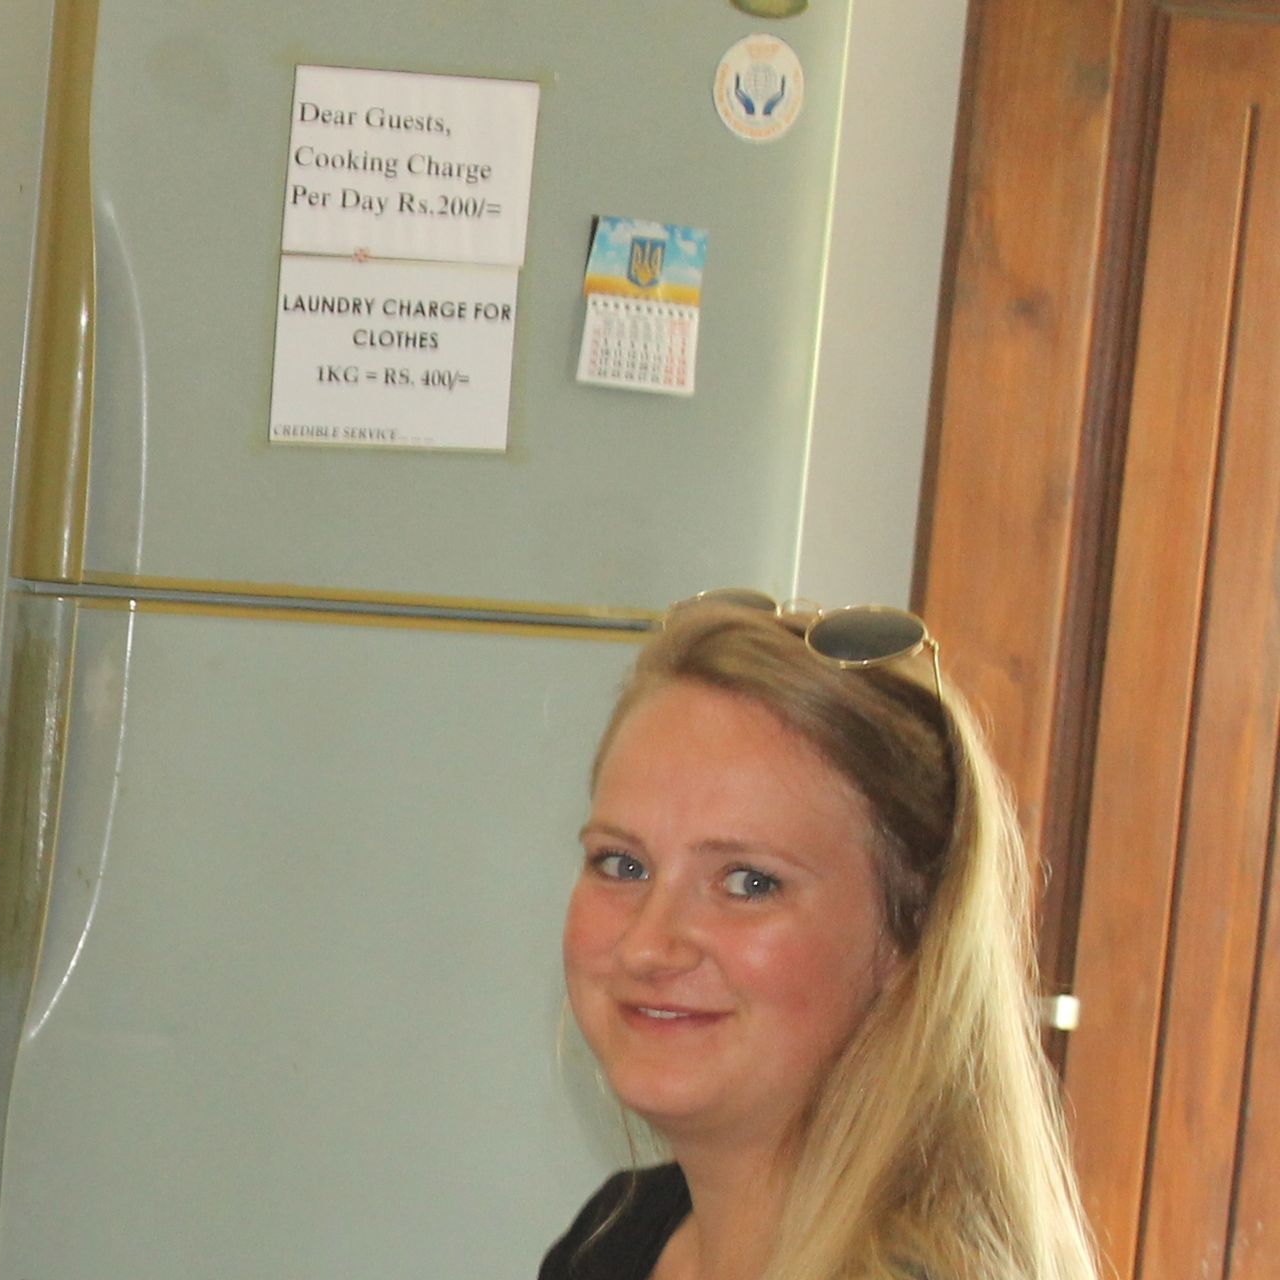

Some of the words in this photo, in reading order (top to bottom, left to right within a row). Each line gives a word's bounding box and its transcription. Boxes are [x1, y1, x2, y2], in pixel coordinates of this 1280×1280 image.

[299, 101, 358, 126] Dear
[365, 106, 452, 136] Guests,
[294, 145, 400, 178] Cooking
[407, 153, 492, 184] Charge
[291, 184, 331, 206] Per
[340, 188, 389, 216] Day
[398, 192, 503, 219] Rs.200/=
[282, 294, 376, 316] LAUNDRY
[382, 298, 467, 319] CHARGE
[473, 303, 512, 321] FOR
[352, 328, 439, 350] CLOTHES
[318, 365, 359, 384] 1KG
[366, 371, 378, 380] =
[383, 368, 415, 386] RS.
[421, 369, 470, 392] 400/=
[273, 424, 339, 438] CREDIBLE
